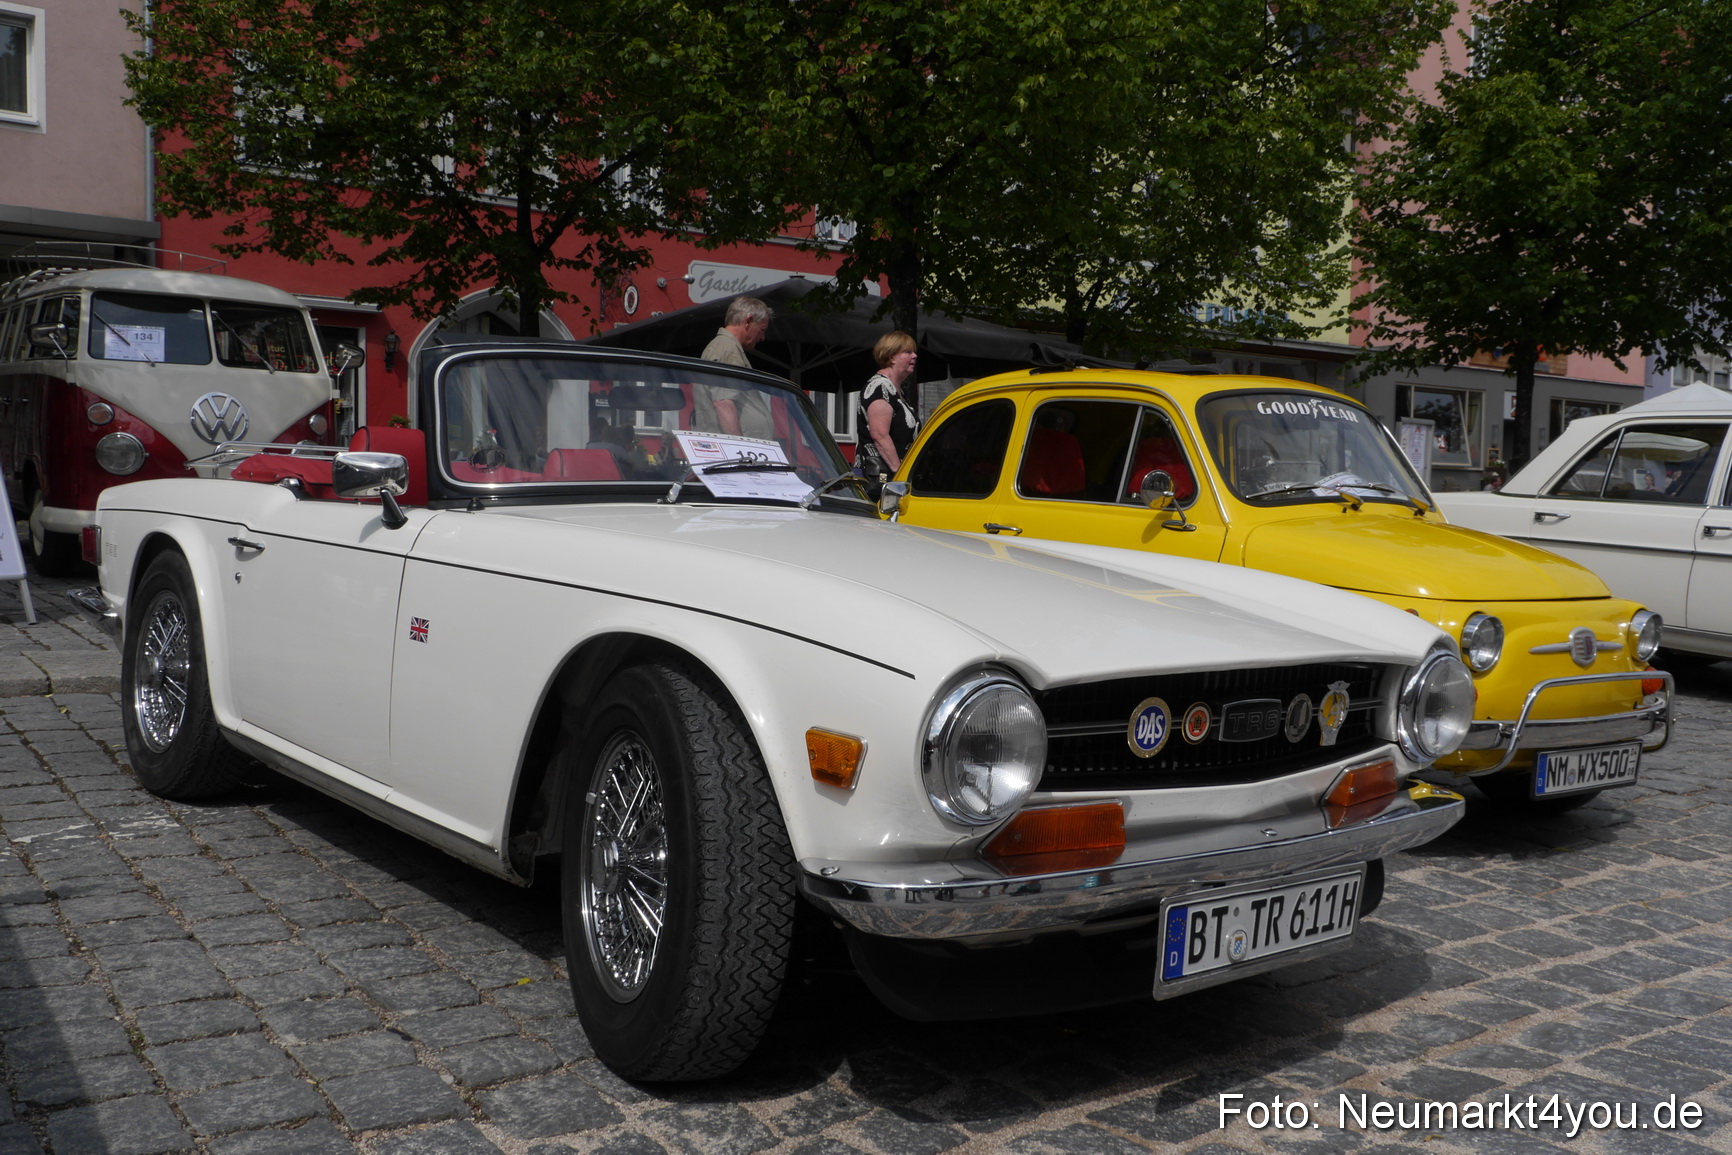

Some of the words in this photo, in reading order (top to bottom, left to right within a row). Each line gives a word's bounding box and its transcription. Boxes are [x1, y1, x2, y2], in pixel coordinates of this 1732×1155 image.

[134, 332, 153, 340] 134
[1257, 400, 1359, 423] GOODYEAR
[1137, 712, 1164, 745] DAS
[1229, 709, 1279, 733] TR6
[1546, 756, 1569, 788] NM
[1188, 906, 1229, 965] BT
[1251, 895, 1285, 949] TR
[1289, 881, 1358, 940] 611H
[1170, 951, 1178, 967] D
